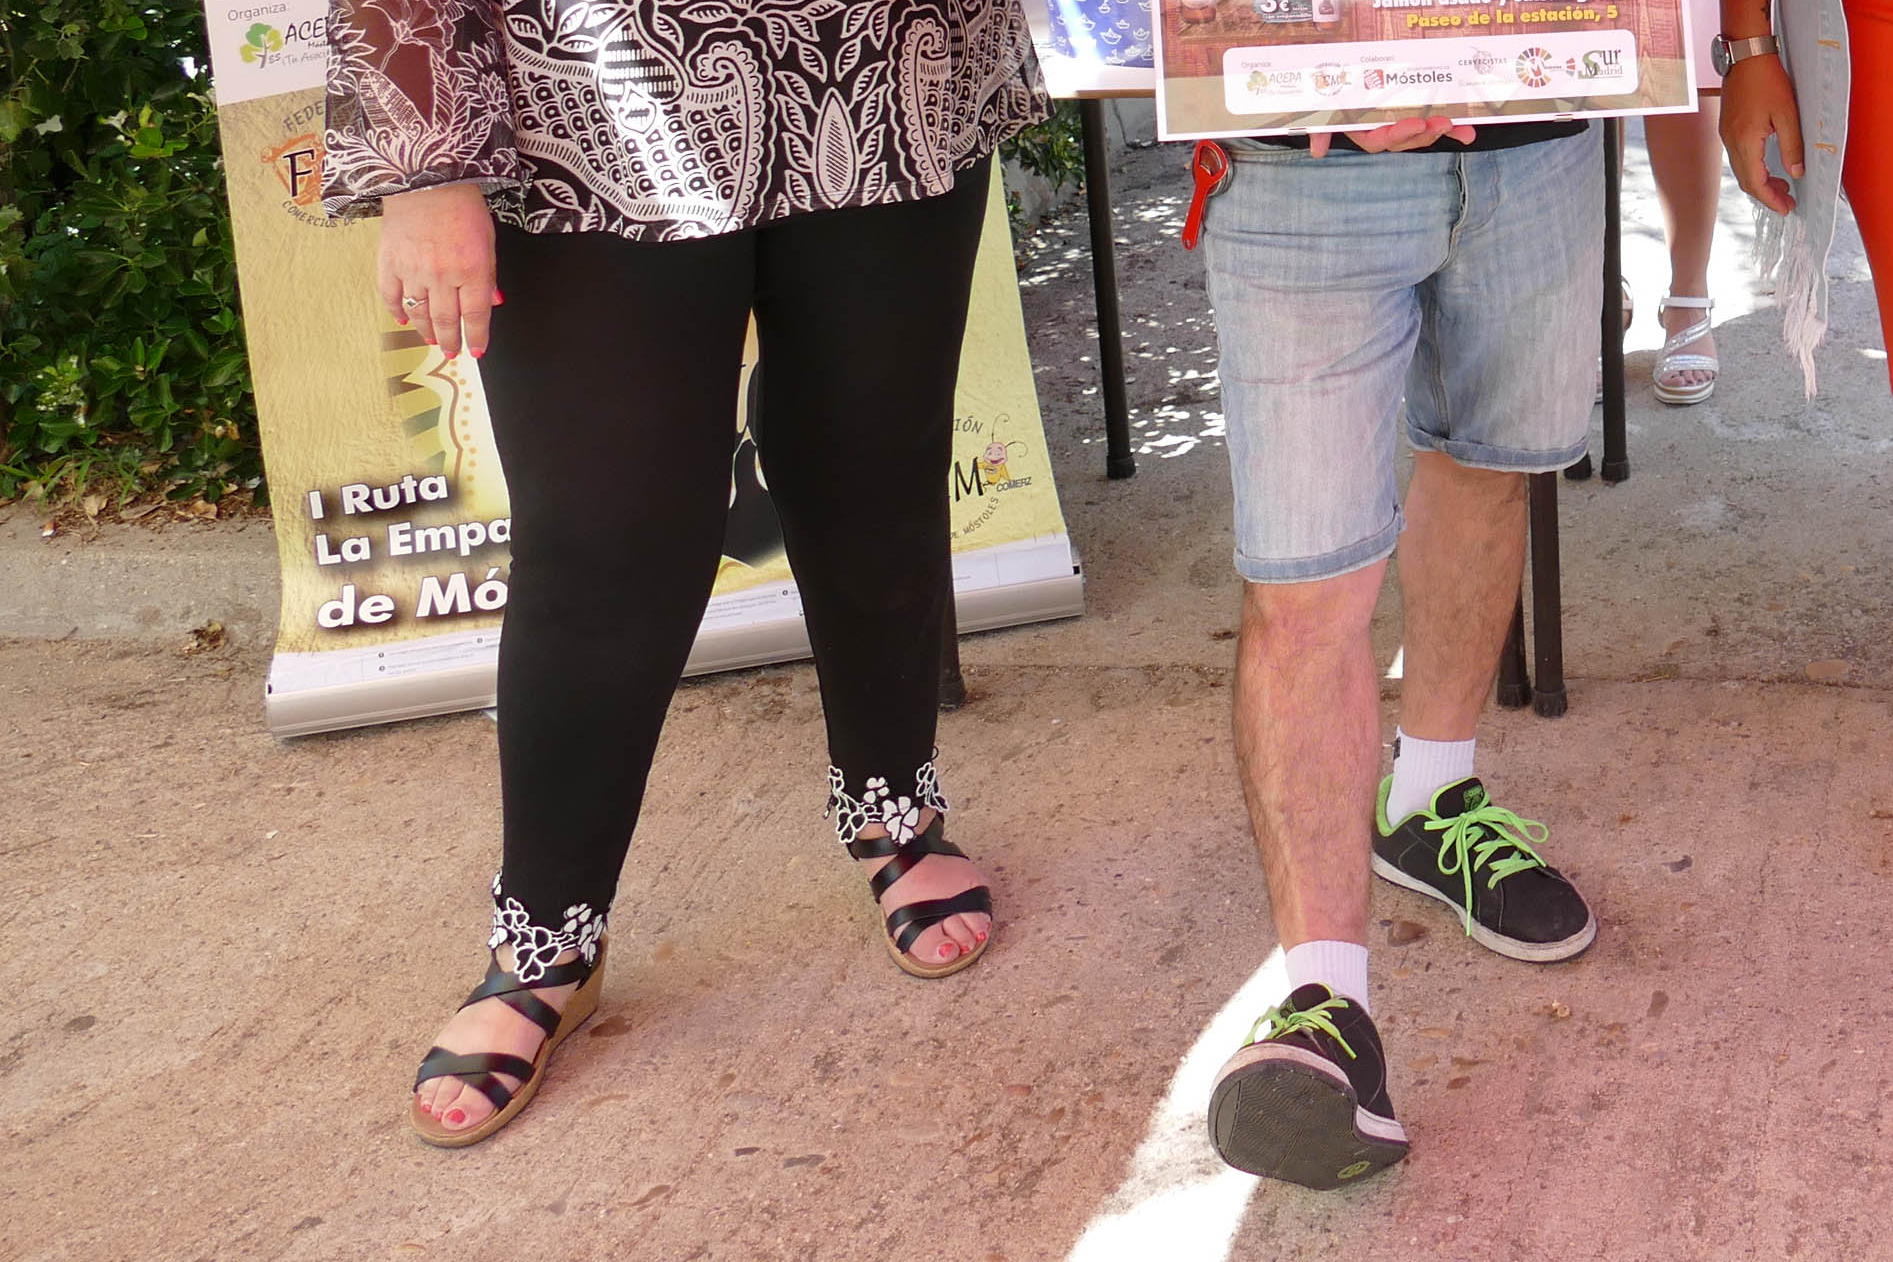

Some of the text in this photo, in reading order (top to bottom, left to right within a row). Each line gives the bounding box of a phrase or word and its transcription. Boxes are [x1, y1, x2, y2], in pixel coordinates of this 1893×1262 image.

[228, 3, 287, 21] Organiza
[1406, 5, 1619, 29] Paseo de la estación, 5
[1386, 71, 1453, 85] Móstoles
[1585, 63, 1623, 77] Madrid
[282, 201, 338, 228] COMERCIOS
[308, 473, 449, 521] I Ruta
[962, 497, 1000, 536] MÓSTOLES
[314, 534, 371, 566] La
[317, 584, 395, 630] de
